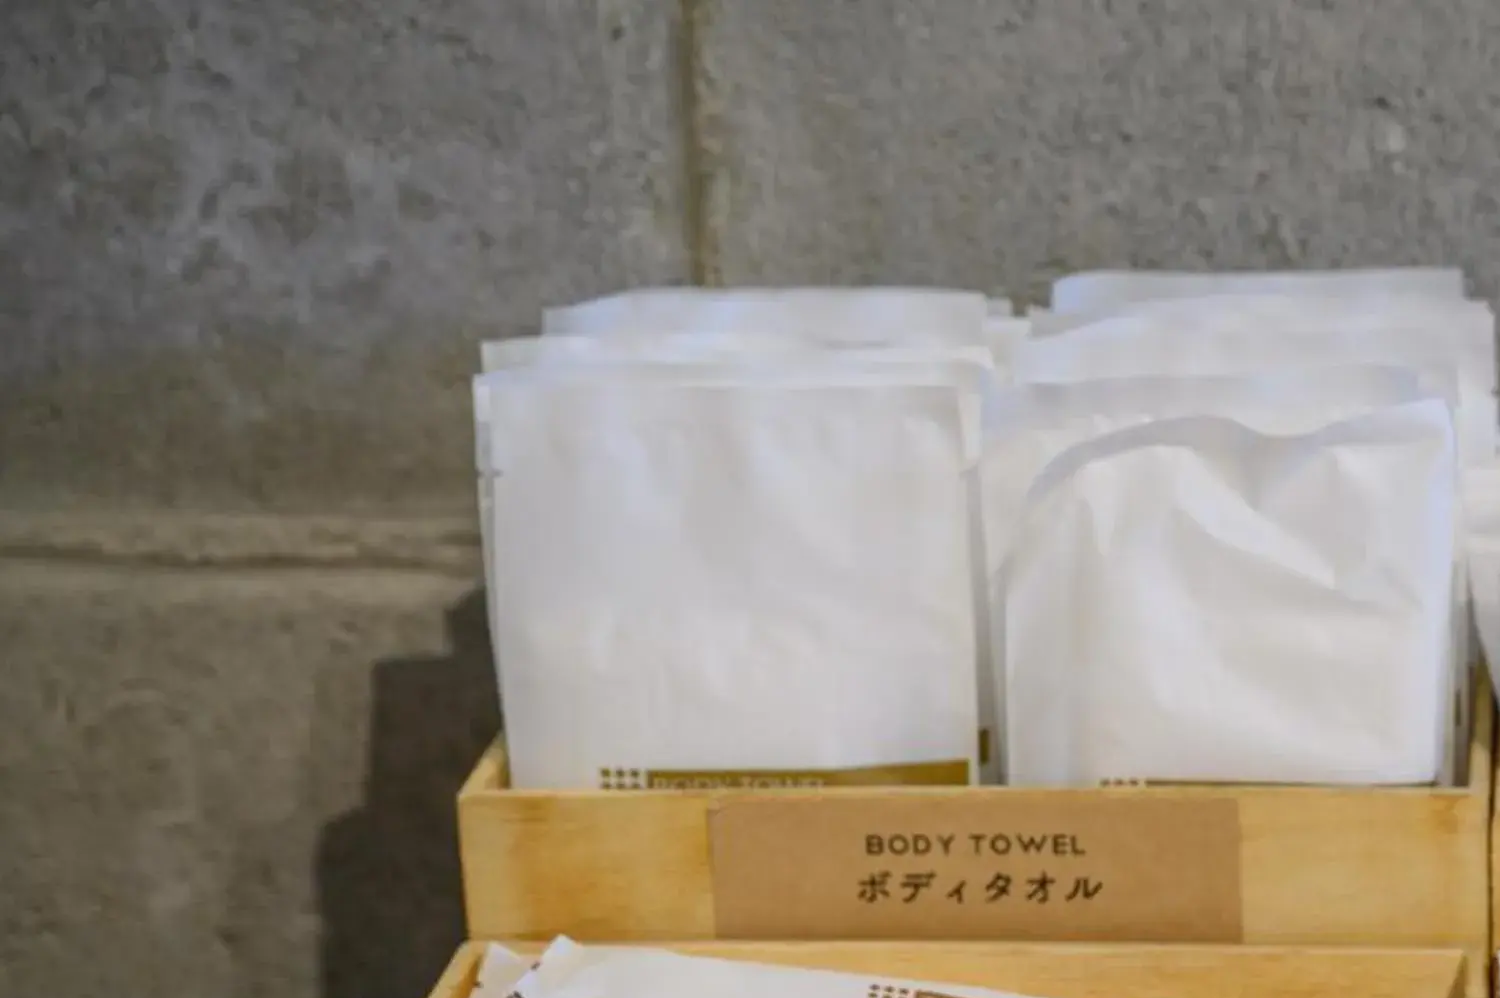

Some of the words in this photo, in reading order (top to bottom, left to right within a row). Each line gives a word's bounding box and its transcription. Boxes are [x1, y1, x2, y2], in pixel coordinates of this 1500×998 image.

[865, 834, 955, 856] BODY
[968, 834, 1086, 856] TOWEL
[857, 871, 1103, 903] ボディタオル
